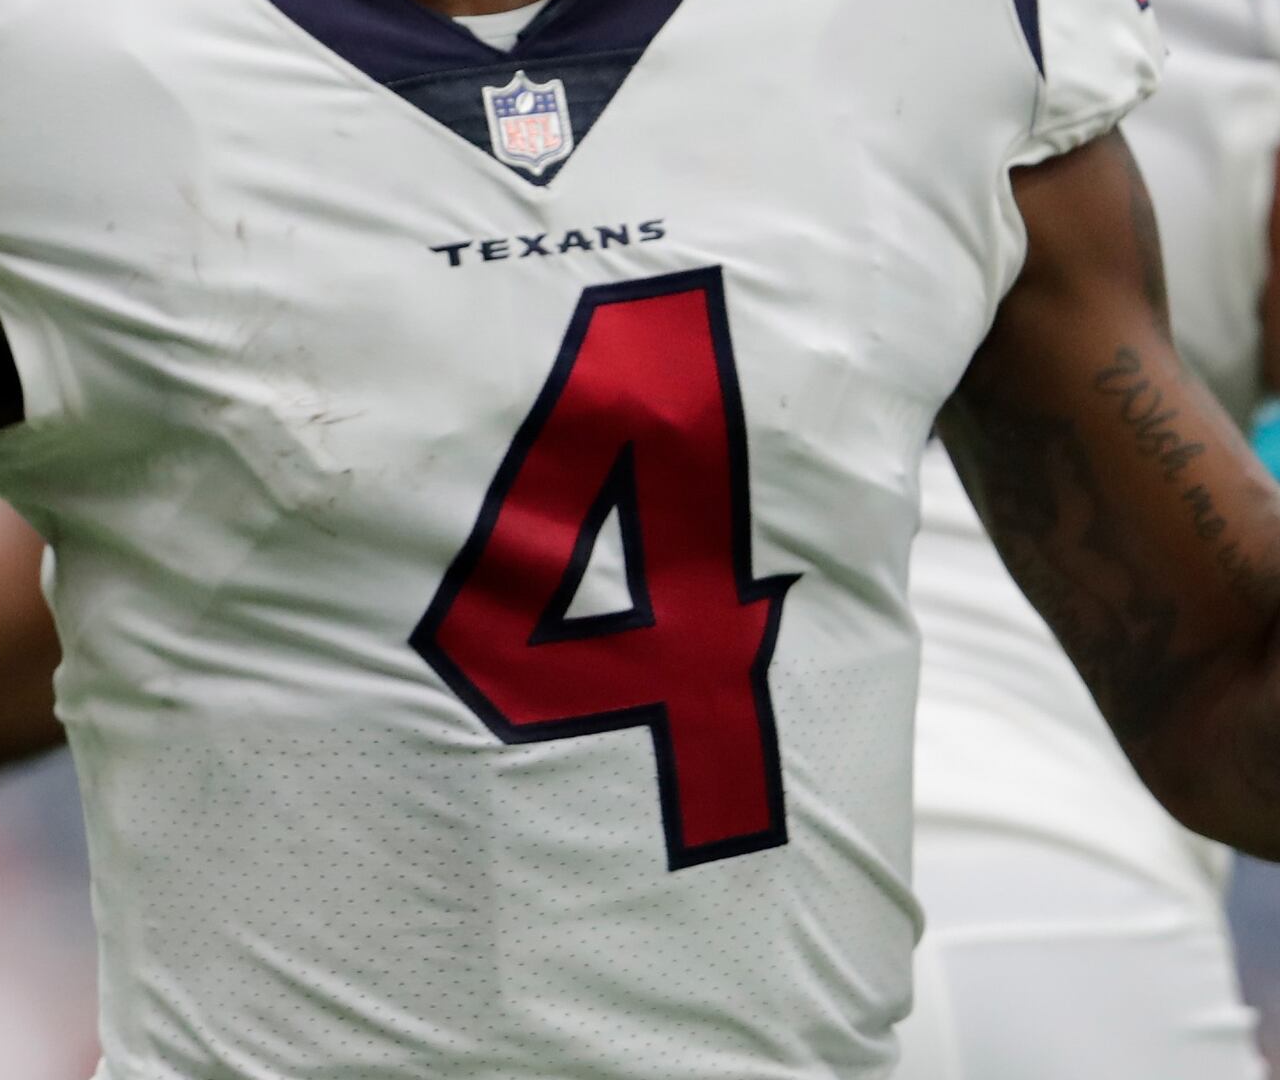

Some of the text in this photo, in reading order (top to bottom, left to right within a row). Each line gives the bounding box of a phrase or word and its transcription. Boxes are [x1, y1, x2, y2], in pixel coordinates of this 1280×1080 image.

[504, 116, 562, 154] NFL
[429, 219, 667, 267] TEXANS
[409, 266, 803, 871] 4
